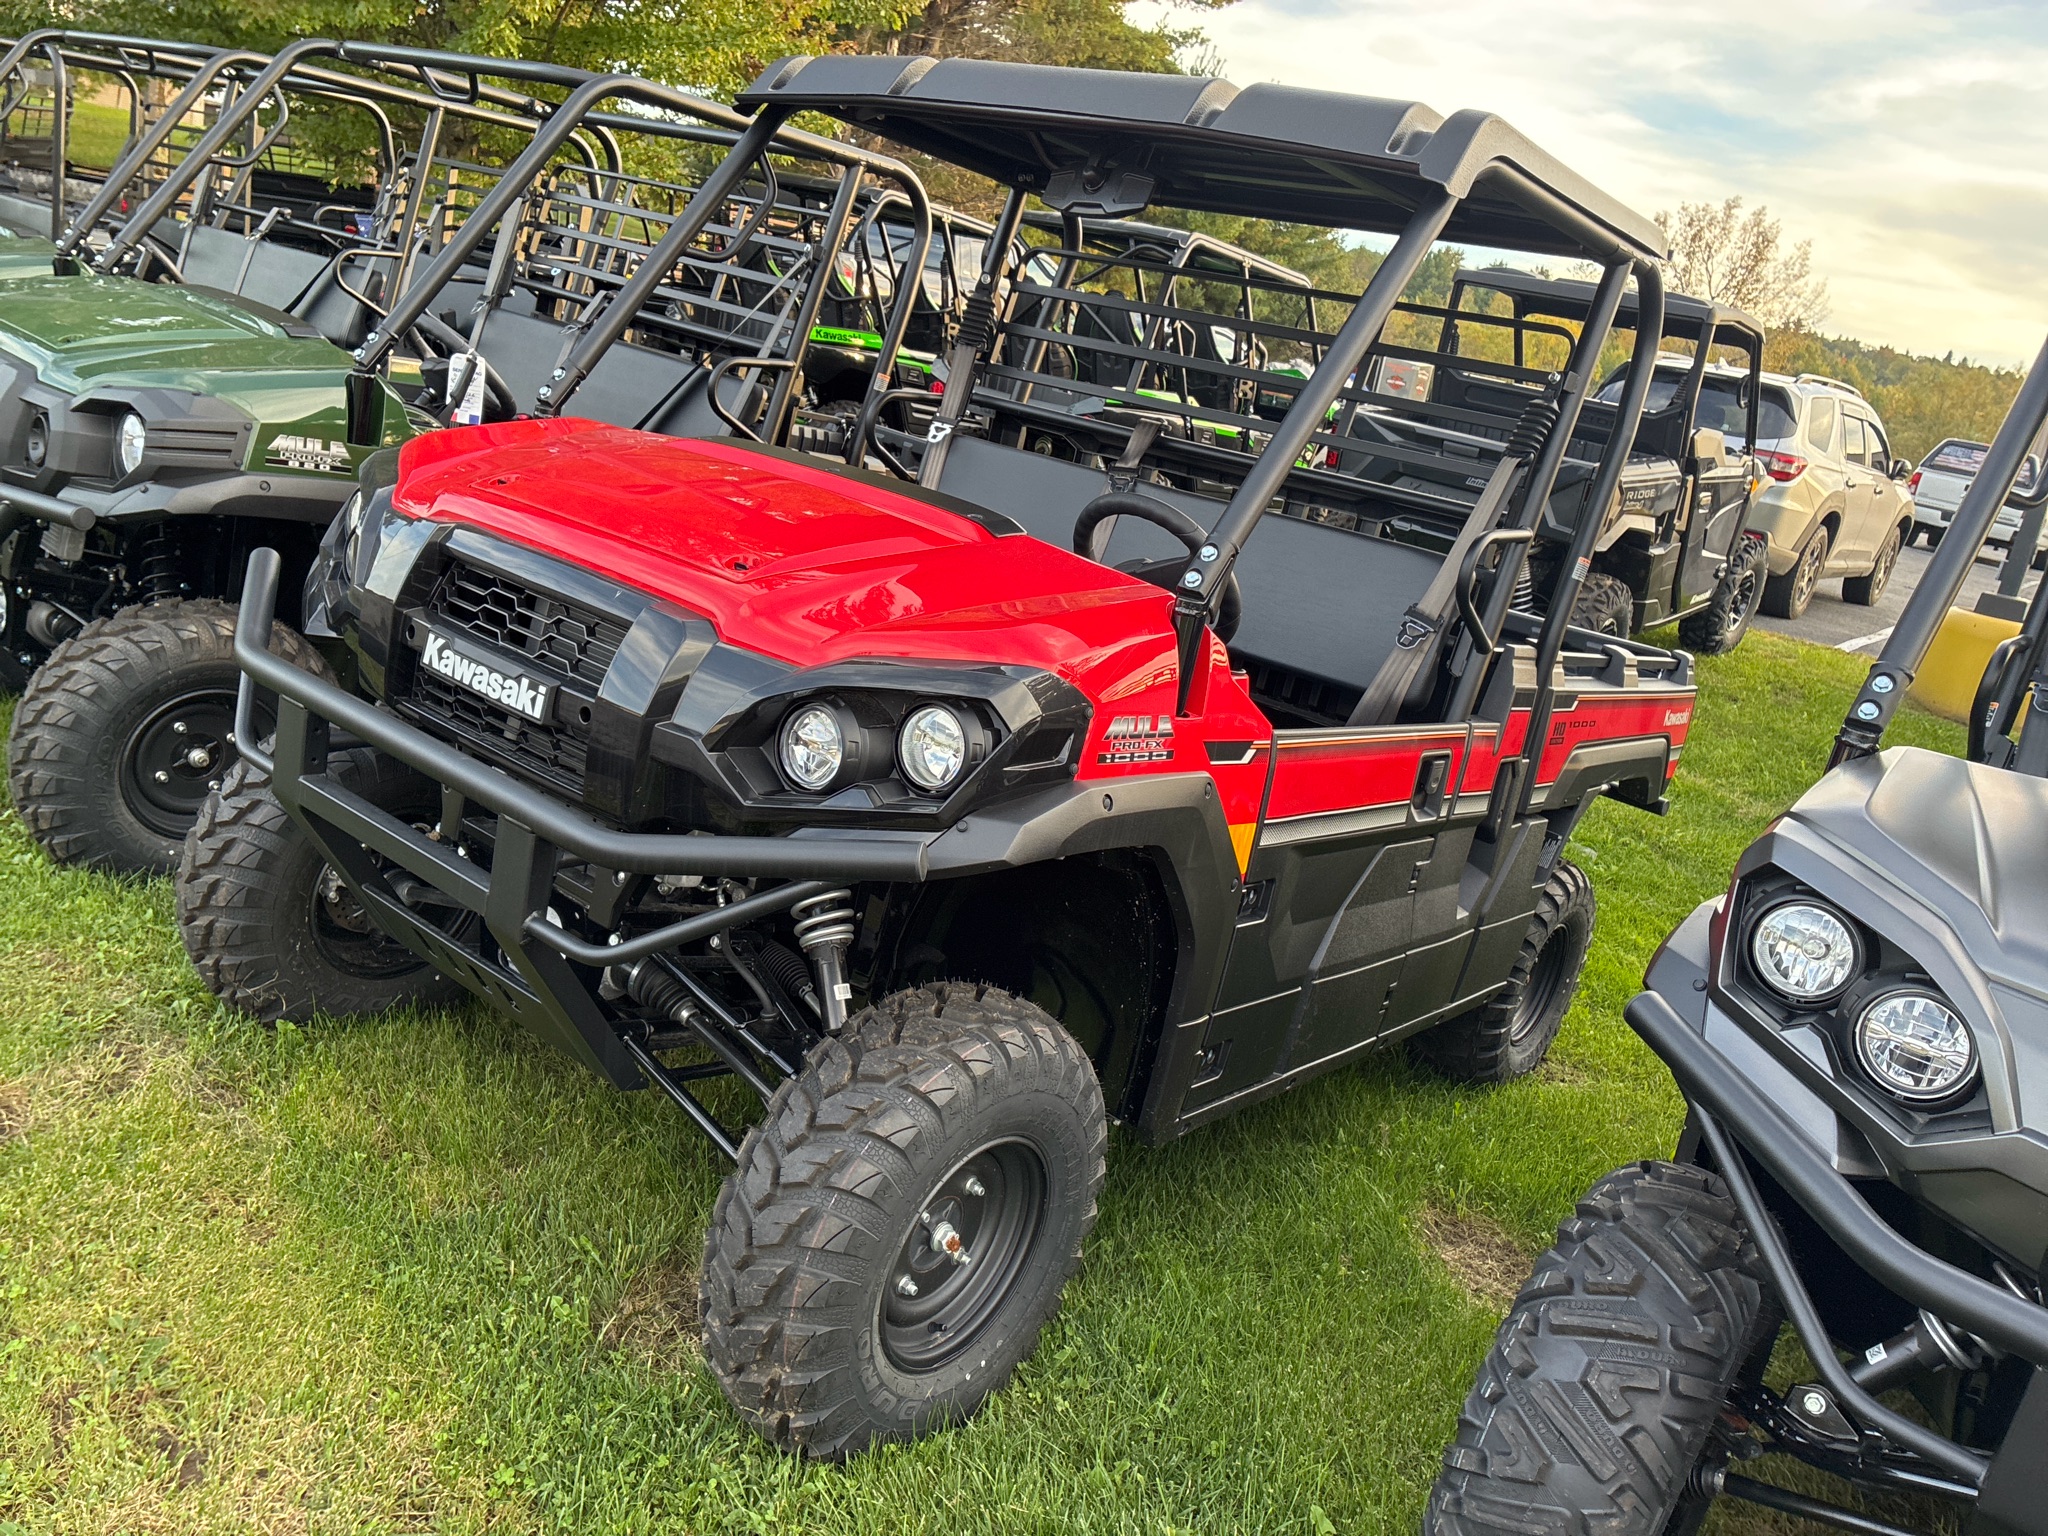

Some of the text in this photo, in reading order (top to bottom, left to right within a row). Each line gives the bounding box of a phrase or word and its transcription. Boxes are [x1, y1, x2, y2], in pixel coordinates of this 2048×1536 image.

[814, 328, 862, 342] Kawasaki
[267, 434, 352, 460] MULE
[1626, 488, 1657, 500] RIDGE
[422, 632, 547, 720] Kawasaki
[1663, 708, 1691, 727] Kawasaki
[1102, 715, 1175, 741] MULE
[1552, 720, 1596, 737] HD 1000
[1105, 751, 1168, 763] 1000
[857, 1326, 924, 1420] DURO
